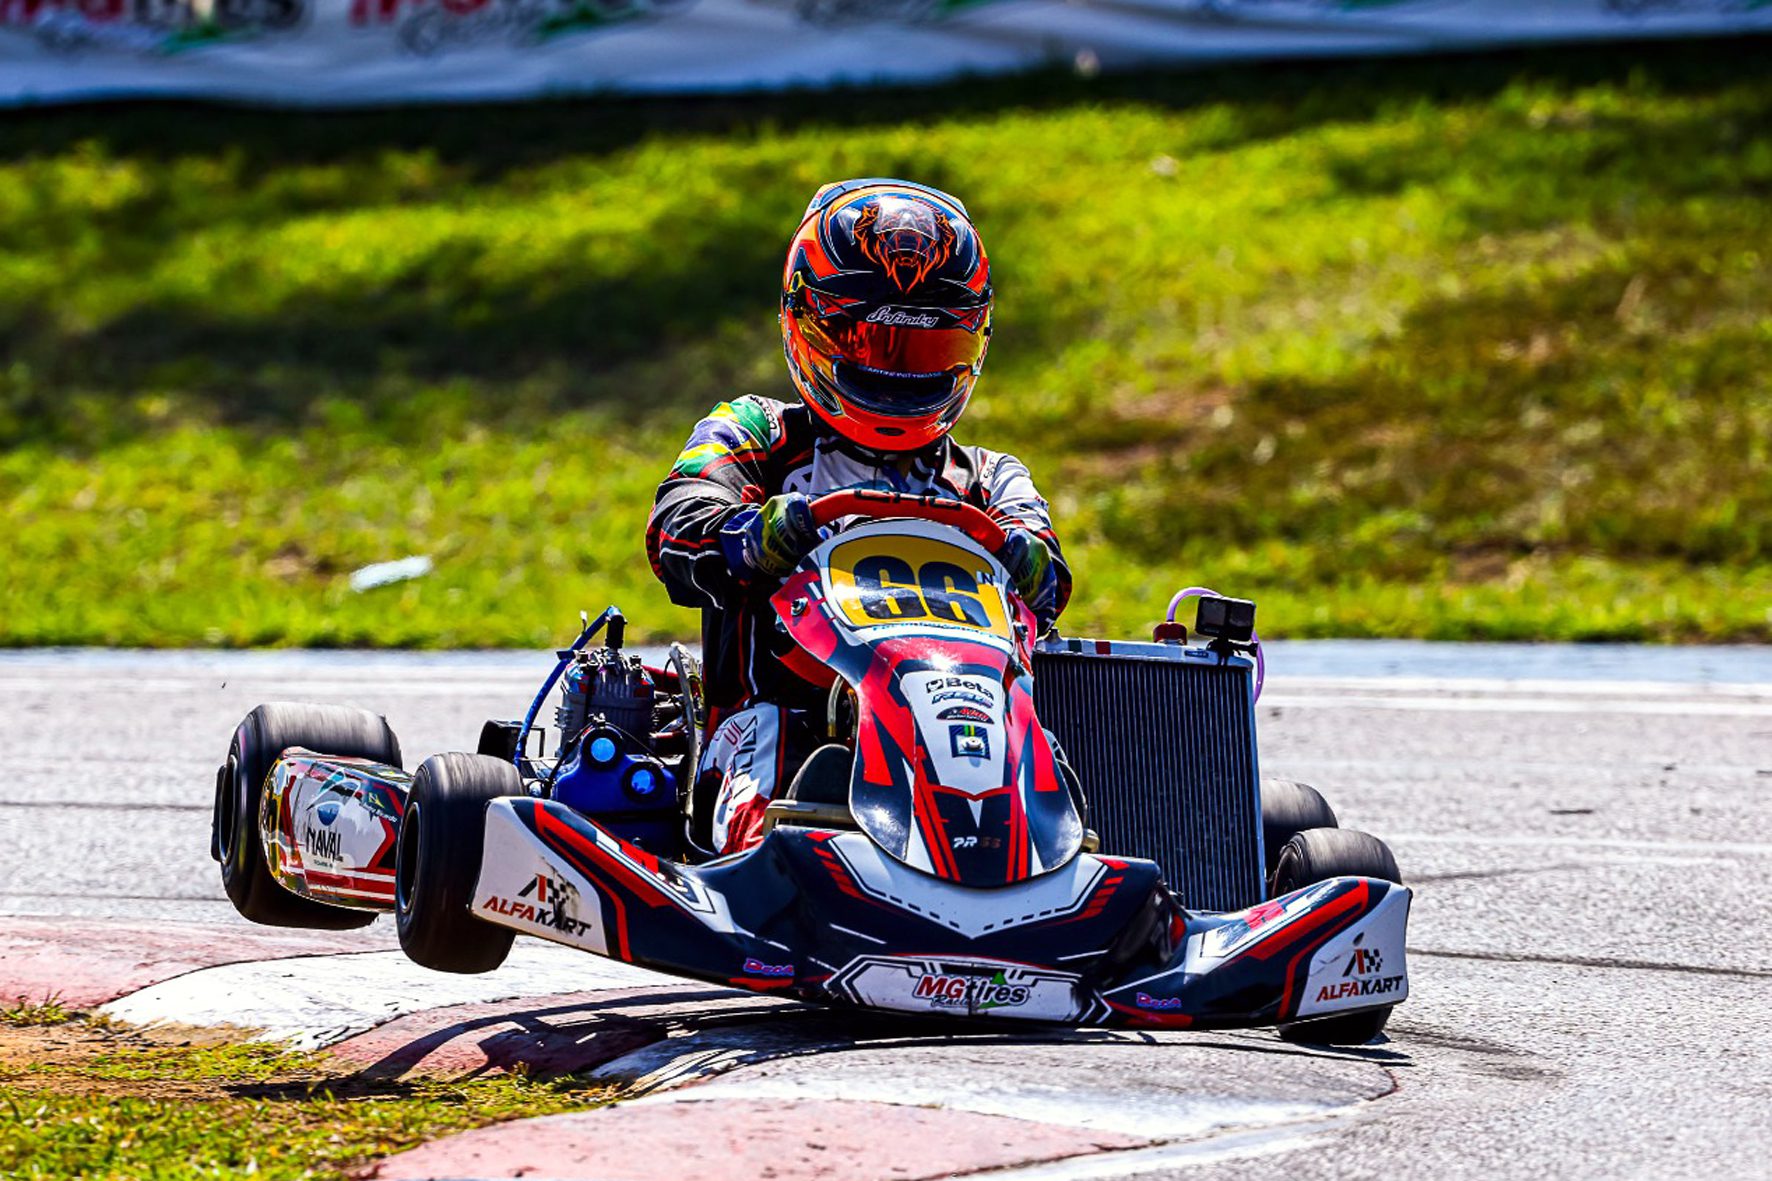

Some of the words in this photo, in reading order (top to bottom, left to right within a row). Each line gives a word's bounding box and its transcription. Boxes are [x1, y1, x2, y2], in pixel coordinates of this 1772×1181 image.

[853, 555, 992, 628] 66
[946, 677, 994, 701] Beta
[483, 896, 592, 936] ALFAKART
[914, 975, 1028, 1005] MGtires
[1315, 975, 1403, 1002] ALFAKART
